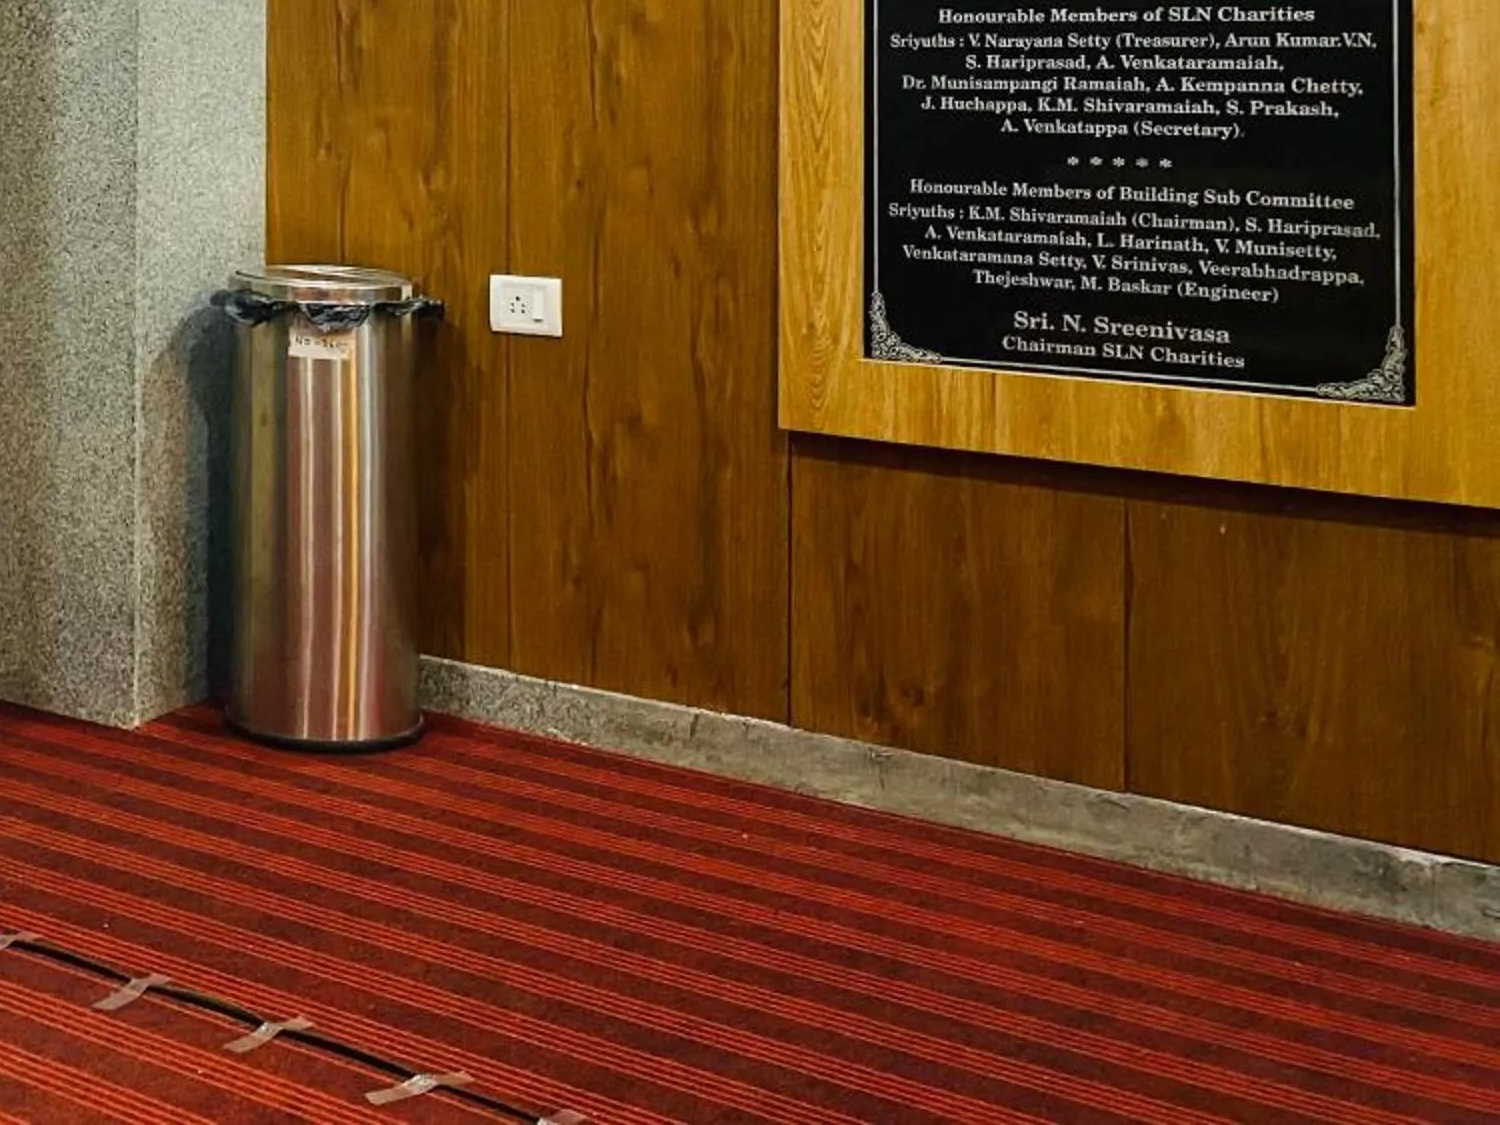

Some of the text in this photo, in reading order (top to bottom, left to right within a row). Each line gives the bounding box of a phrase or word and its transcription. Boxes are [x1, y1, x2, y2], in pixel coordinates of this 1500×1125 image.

[938, 6, 1314, 23] Honourable Members of SLN Charities
[890, 33, 955, 50] Sriyuths
[968, 32, 980, 47] V.
[984, 33, 1063, 50] Narayana
[1067, 32, 1111, 50] Setty
[1116, 32, 1220, 49] (Treasurer),
[1224, 32, 1270, 47] Arun
[965, 54, 1284, 72] S. Hariprasad, A. Venkataramaiah,
[931, 75, 1057, 93] Munisampangi
[1063, 76, 1150, 92] Ramaiah,
[1155, 76, 1174, 91] A.
[1180, 76, 1284, 95] Kempanna
[1291, 76, 1363, 97] Chetty,
[920, 95, 1339, 118] J. Huchappa, K.M. Shivaramaiah, S. Prakash,
[1000, 118, 1018, 132] A.
[1023, 118, 1128, 137] Venkatappa
[910, 178, 1354, 209] Honourable Members of Building Sub Committee
[888, 202, 955, 219] Sriyuths
[969, 205, 1004, 221] K.M.
[1009, 206, 1126, 226] Shivaramaiah
[1131, 212, 1240, 233] (Chairman),
[1245, 217, 1262, 232] S.
[1267, 218, 1380, 239] Hariprasad,
[924, 224, 1336, 262] A. Venkataramaiah, L. Harinath, V. Munisetty,
[902, 244, 1364, 286] Venkataramana Setty, V. Srinivas, Veerabhadrappa,
[972, 268, 1278, 303] Thejeshwar, M. Baskar (Engineer)
[1014, 310, 1230, 343] Sri. N. Sreenivasa
[1001, 334, 1244, 368] Chairman SLN Charities
